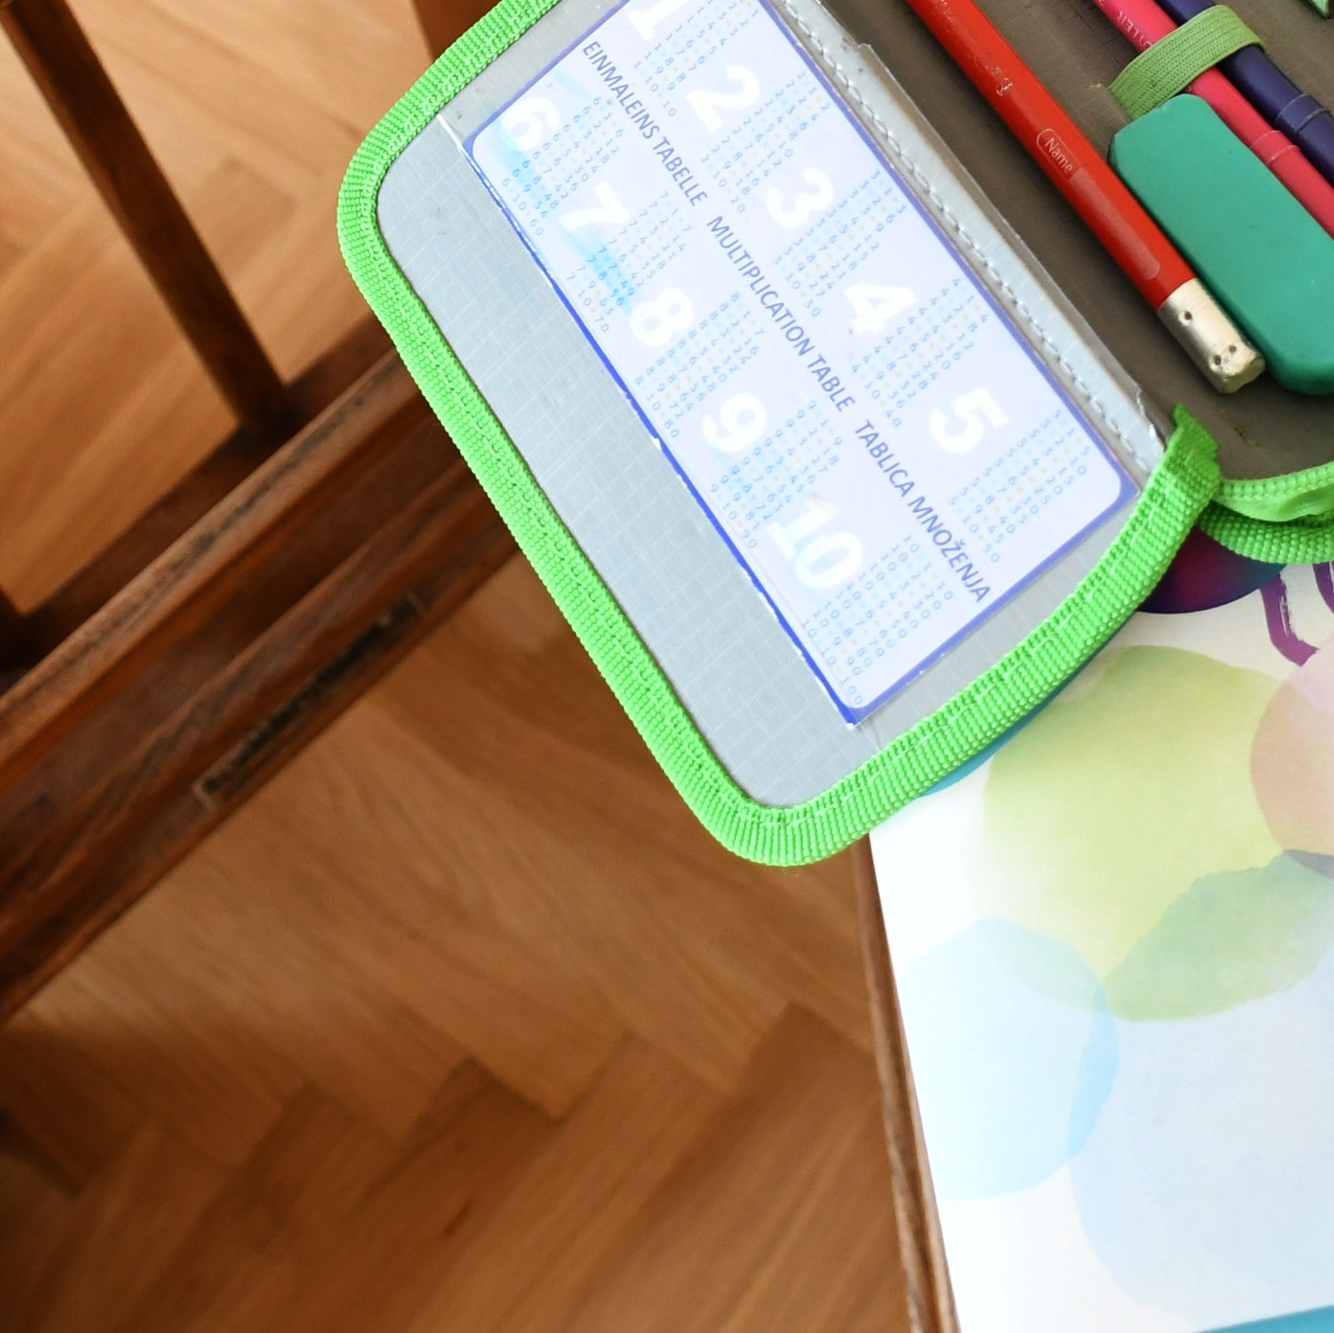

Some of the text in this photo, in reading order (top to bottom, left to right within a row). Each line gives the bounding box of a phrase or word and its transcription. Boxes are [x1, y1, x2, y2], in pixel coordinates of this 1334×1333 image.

[501, 96, 559, 150] 6
[583, 41, 707, 206] EINMALEINS TABELLE
[685, 64, 760, 132] 2
[1042, 137, 1075, 174] Name
[558, 179, 632, 234] 7
[766, 168, 833, 227] 3
[629, 288, 694, 346] 8
[707, 215, 853, 411] MULTIPLICATION TABLE
[842, 287, 919, 335] 4
[703, 394, 768, 454] 9
[929, 385, 1010, 452] 5
[854, 420, 991, 601] TABLICA MNOŽENJA
[764, 500, 862, 590] 10
